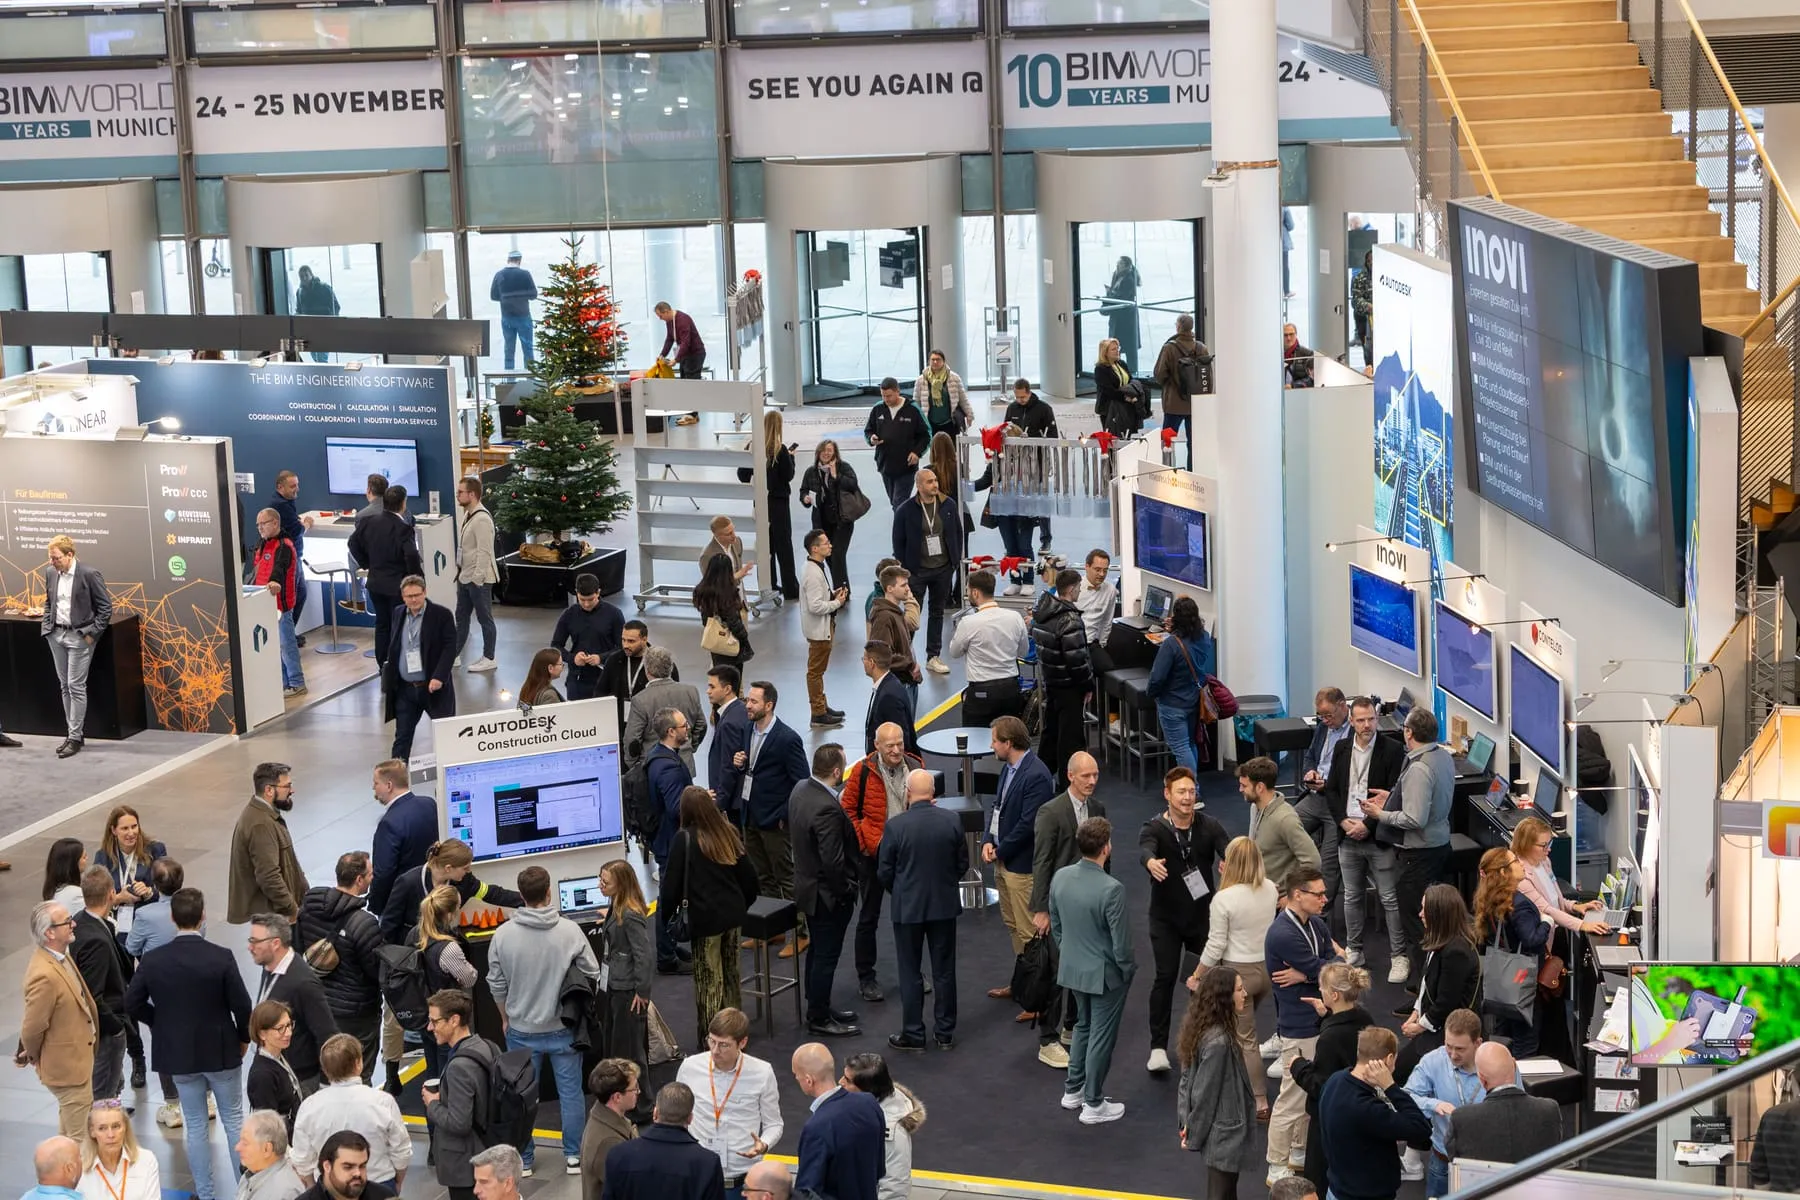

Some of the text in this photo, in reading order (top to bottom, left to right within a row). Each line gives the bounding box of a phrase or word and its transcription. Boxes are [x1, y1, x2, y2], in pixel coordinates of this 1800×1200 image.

[1066, 49, 1211, 81] BIMWO
[1279, 61, 1310, 83] 24
[748, 71, 984, 100] SEE YOU AGAIN @
[1008, 53, 1062, 108] 10
[195, 95, 227, 118] 24
[254, 93, 284, 116] 25
[293, 88, 446, 115] NOVEMBER
[1089, 88, 1149, 104] YEARS
[11, 123, 71, 138] YEARS
[1386, 277, 1412, 296] AUTODESK
[250, 373, 435, 389] THE BIM ENGINEERING SOFTWARE
[289, 402, 336, 410] CONSTRUCTION
[347, 404, 389, 412] CALCULATION
[248, 414, 295, 422] COORDINATION
[304, 416, 356, 424] COLLABORATION
[364, 417, 392, 425] INDUSTRY
[1539, 630, 1563, 655] CONTELOS
[477, 715, 557, 736] AUTODESK
[477, 726, 597, 752] Construction Cloud
